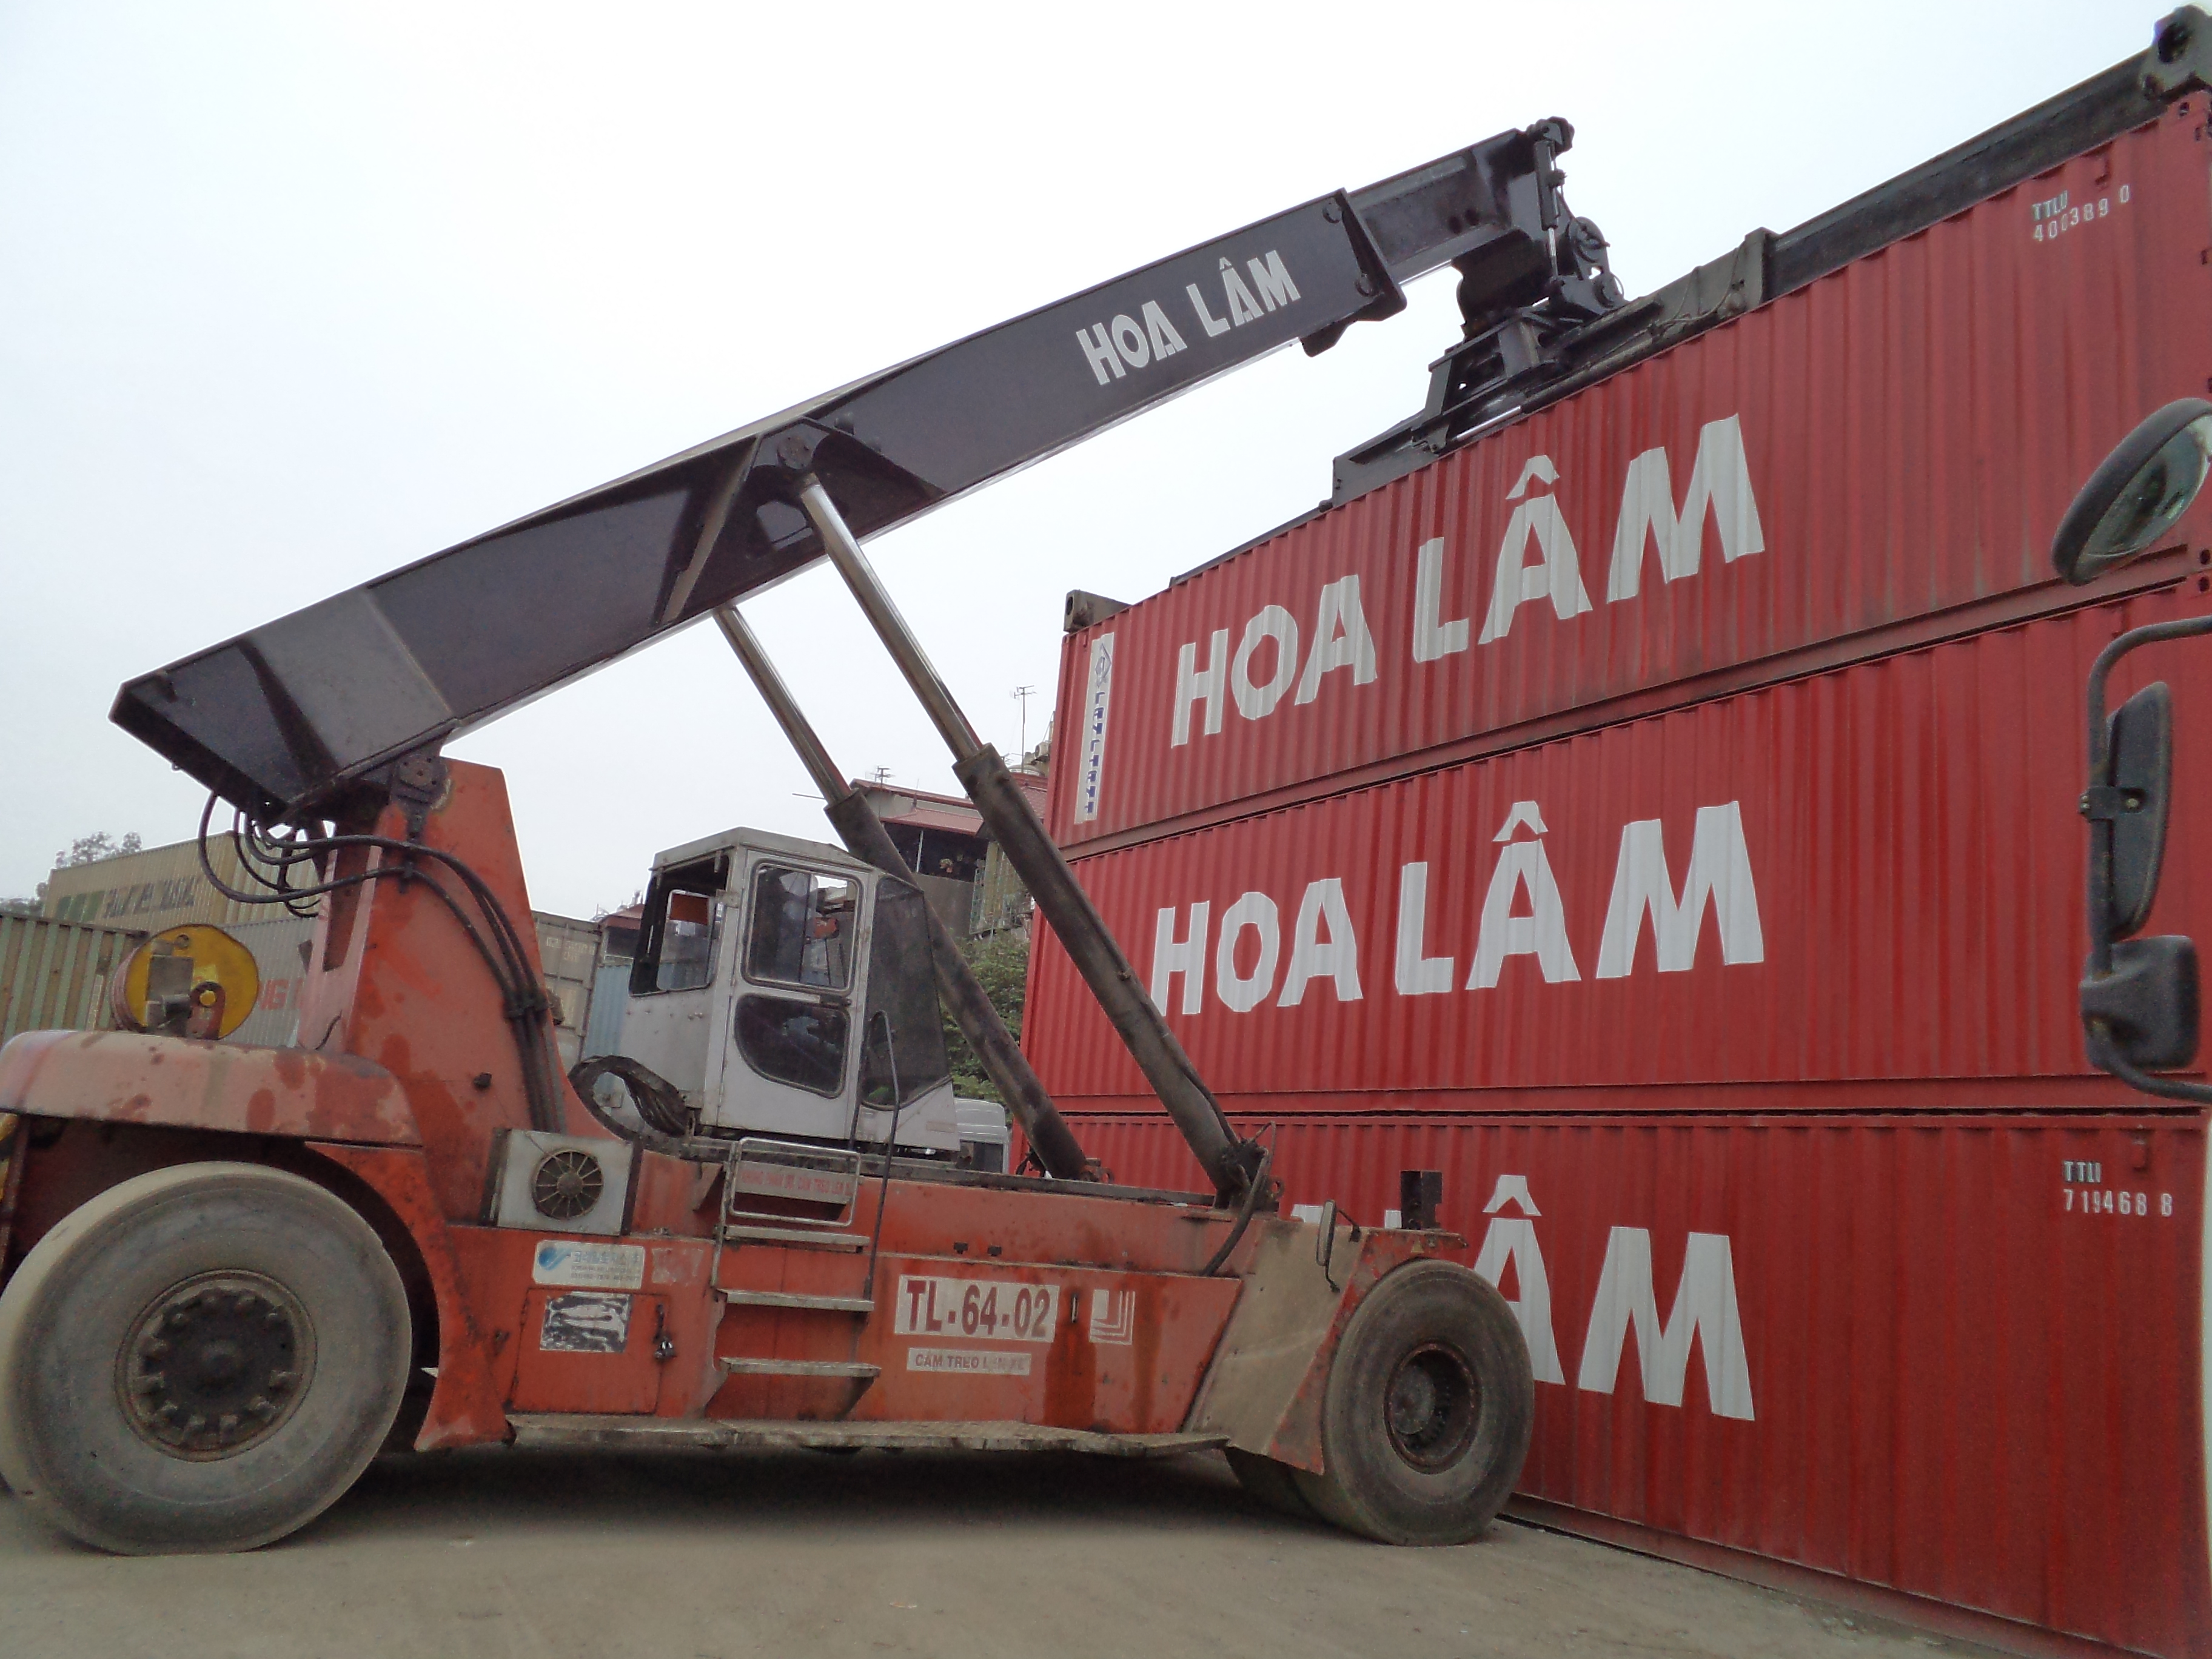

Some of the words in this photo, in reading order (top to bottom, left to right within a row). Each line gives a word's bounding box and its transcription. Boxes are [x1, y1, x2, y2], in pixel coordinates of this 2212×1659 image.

[1076, 300, 1188, 386] HOA
[1186, 250, 1301, 337] LÂM
[1171, 573, 1378, 748] HOA
[1412, 413, 1765, 663] LÂM
[1150, 877, 1364, 1017] HOA
[1395, 800, 1764, 996] LÂM
[1385, 1175, 1755, 1421] ÂM
